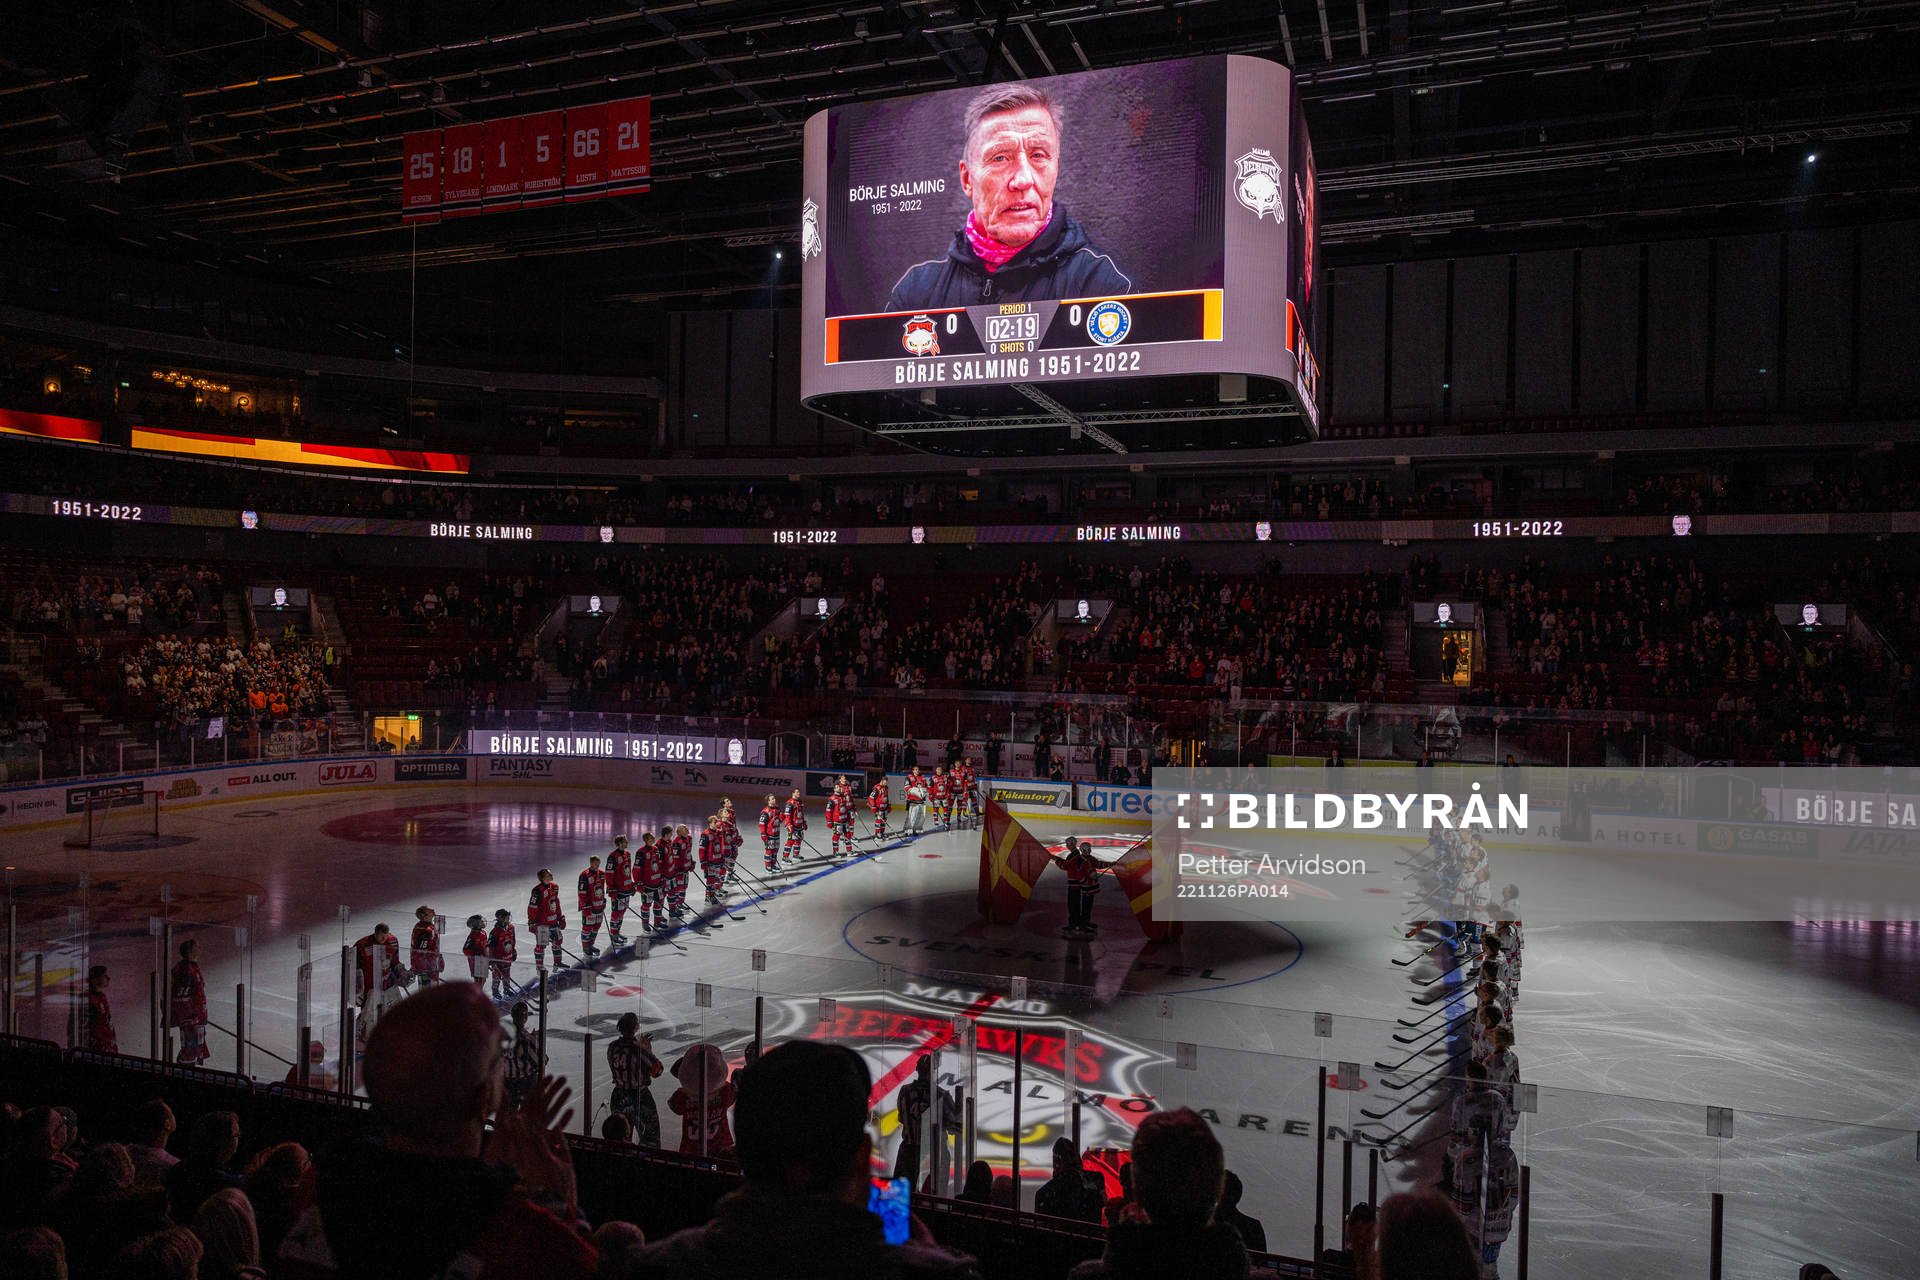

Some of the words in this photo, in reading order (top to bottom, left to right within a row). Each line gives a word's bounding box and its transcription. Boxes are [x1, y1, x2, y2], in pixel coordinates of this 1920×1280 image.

[573, 128, 600, 158] 66
[618, 121, 640, 150] 21
[499, 141, 507, 168] 1
[536, 135, 550, 162] 5
[410, 153, 433, 180] 25
[453, 147, 472, 174] 18
[849, 185, 887, 202] BÖRJE
[890, 178, 945, 198] SALMING
[871, 203, 890, 214] 1951
[899, 199, 922, 212] 2022
[1000, 303, 1026, 315] PERIOD
[1027, 303, 1032, 313] 1
[1069, 304, 1081, 326] 0
[946, 313, 958, 334] 0
[989, 317, 1036, 340] 02:19
[990, 342, 997, 354] 0
[1000, 342, 1024, 353] SHOTS
[1027, 340, 1034, 352] 0
[894, 359, 946, 384] BÖRJE
[952, 357, 1029, 381] SALMING
[1038, 351, 1141, 378] 1951-2022
[52, 500, 142, 520] 1951-2022
[430, 522, 471, 537] BÖRJE
[475, 526, 533, 540] SALMING
[773, 530, 837, 543] 1951-2022
[1077, 526, 1117, 541] BÖRJE
[1121, 526, 1181, 540] SALMING
[1472, 521, 1563, 537] 1951-2022
[490, 734, 540, 753] BÖRJE
[546, 737, 613, 757] SALMING
[625, 739, 703, 761] 1951-2022
[321, 764, 374, 781] JULA
[401, 763, 460, 774] OPTIMERA
[490, 758, 553, 771] FANTASY
[252, 774, 271, 784] ALL
[273, 772, 297, 782] OUT.
[512, 771, 533, 779] SHL
[722, 775, 792, 787] SKECHERS
[994, 790, 1055, 804] Håkantorp
[1087, 791, 1182, 816] areco
[1796, 795, 1873, 824] BÖRJE
[1537, 826, 1605, 841] ARA
[1617, 830, 1686, 846] HOTEL
[1739, 828, 1808, 844] GASAB
[1136, 961, 1227, 981] PEL
[1199, 1108, 1363, 1143] AREN
